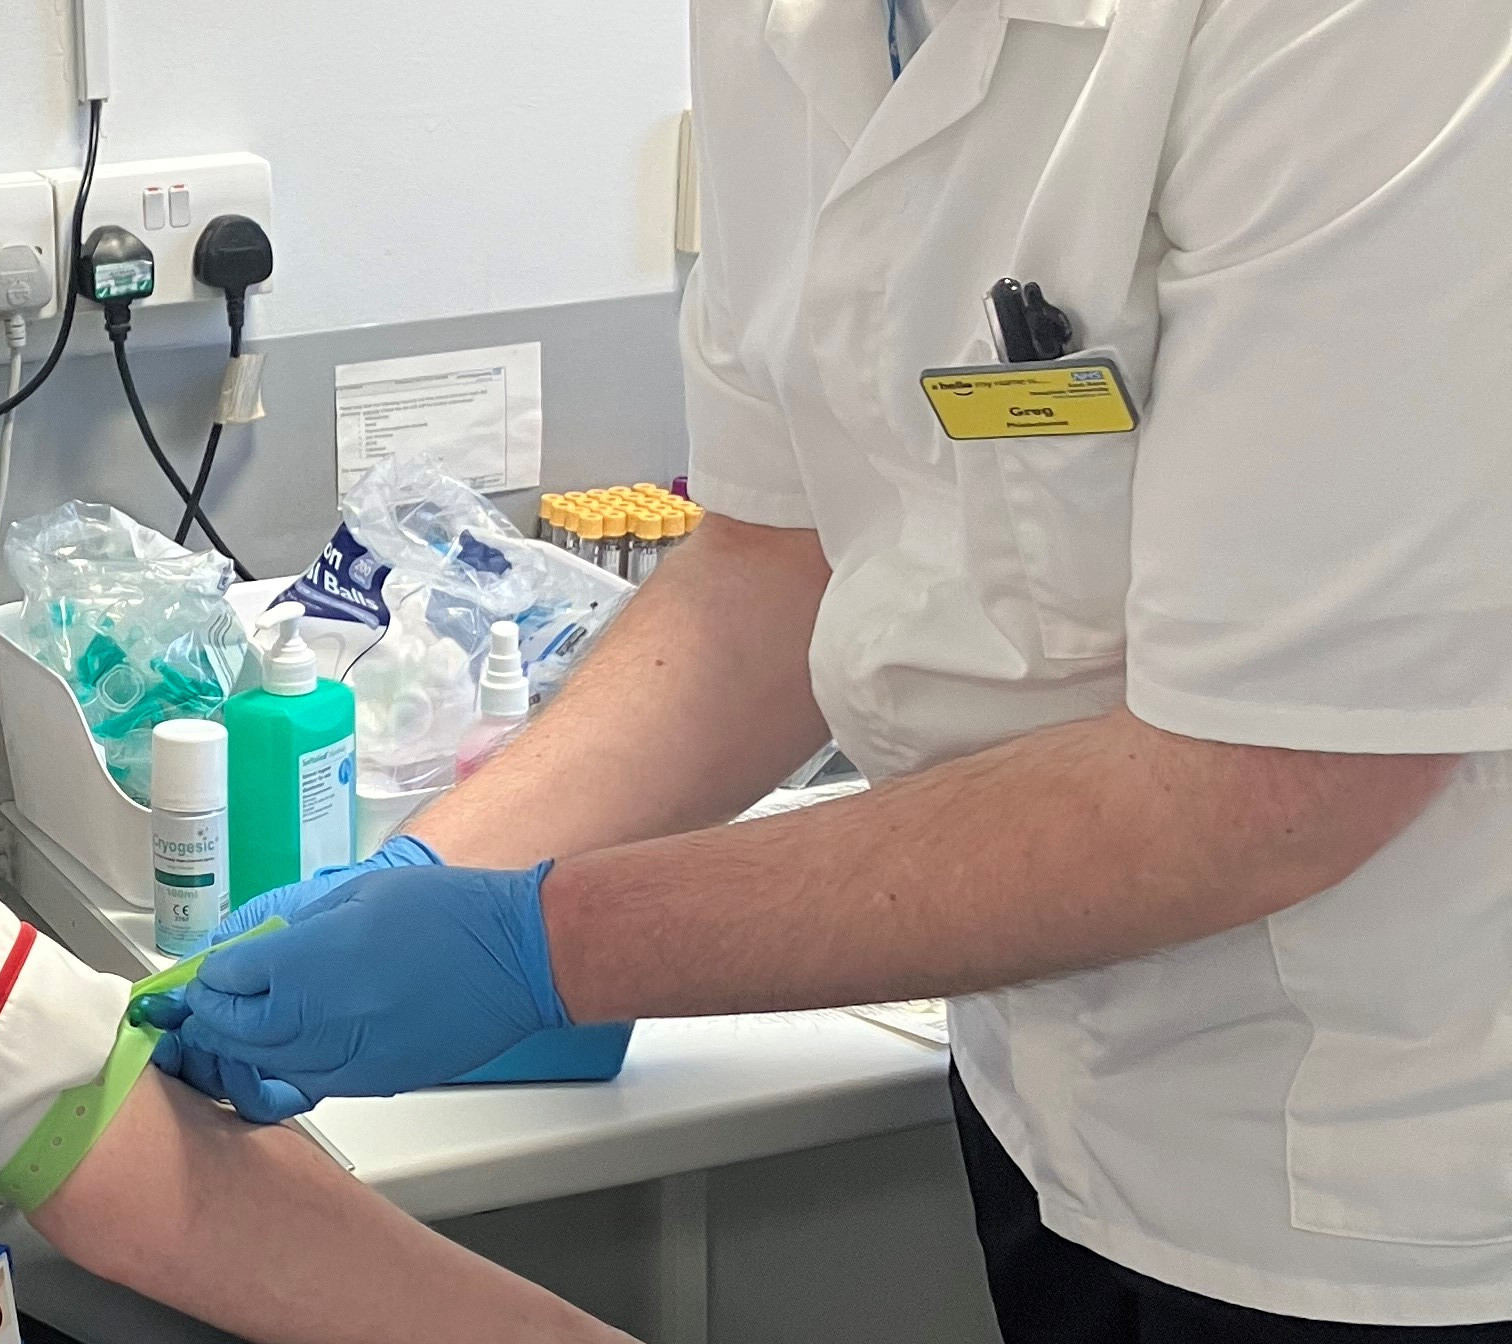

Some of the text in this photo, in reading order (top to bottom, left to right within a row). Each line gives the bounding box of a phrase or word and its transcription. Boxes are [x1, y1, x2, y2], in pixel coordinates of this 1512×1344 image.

[1009, 406, 1054, 418] Greg
[324, 569, 379, 611] Balls
[153, 833, 215, 857] Cryogesic
